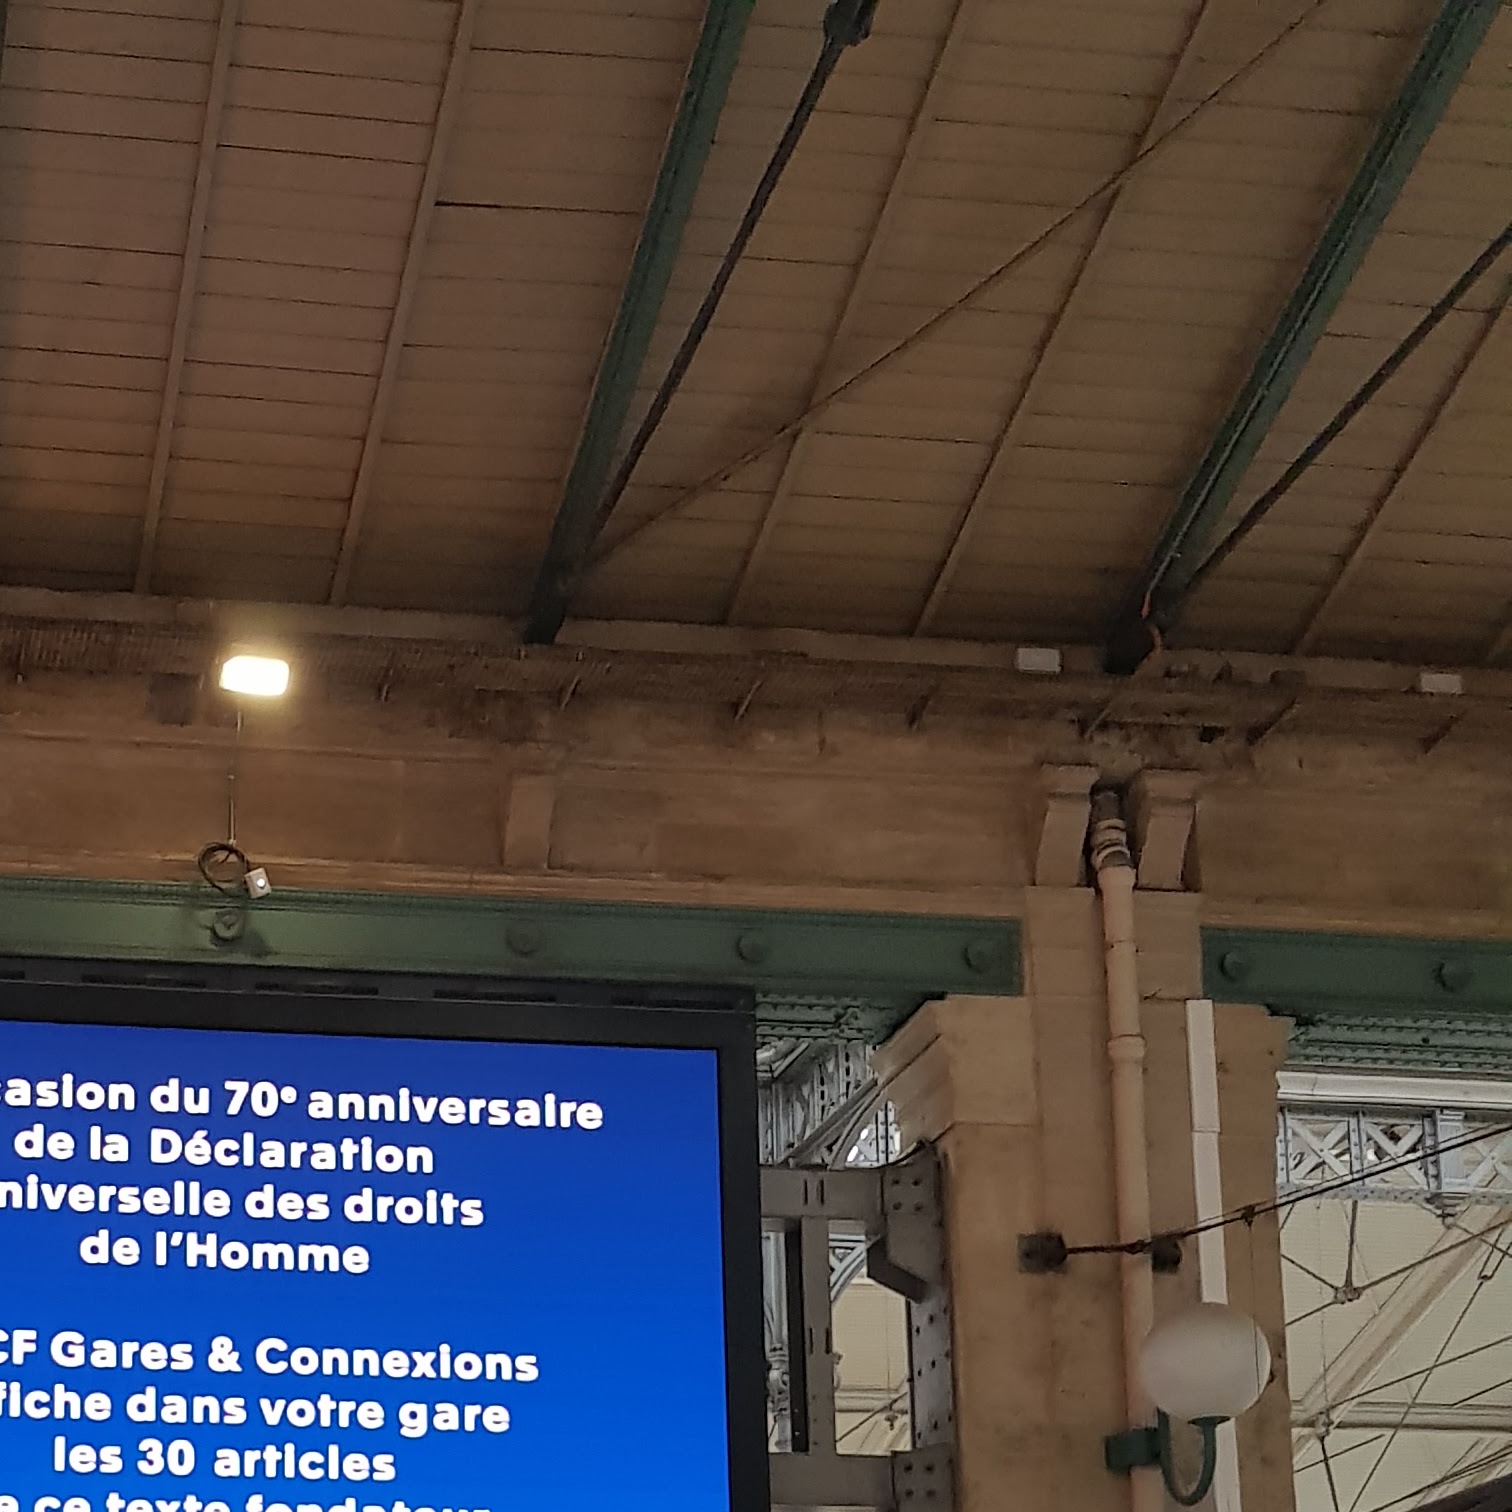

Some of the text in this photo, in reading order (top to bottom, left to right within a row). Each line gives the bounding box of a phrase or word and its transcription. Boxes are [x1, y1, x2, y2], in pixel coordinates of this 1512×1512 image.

[149, 1077, 210, 1114] du
[307, 1087, 603, 1130] anniversaire
[13, 1123, 434, 1174] de la Déclaration
[244, 1183, 330, 1220] des
[343, 1187, 484, 1226] droits
[79, 1228, 141, 1266] de
[50, 1331, 194, 1371] Gares
[207, 1335, 243, 1373] &
[255, 1337, 539, 1382] Connexions
[126, 1385, 247, 1425] dans
[259, 1393, 385, 1430] votre
[398, 1402, 510, 1438] gare
[54, 1435, 396, 1481] les 30 articles
